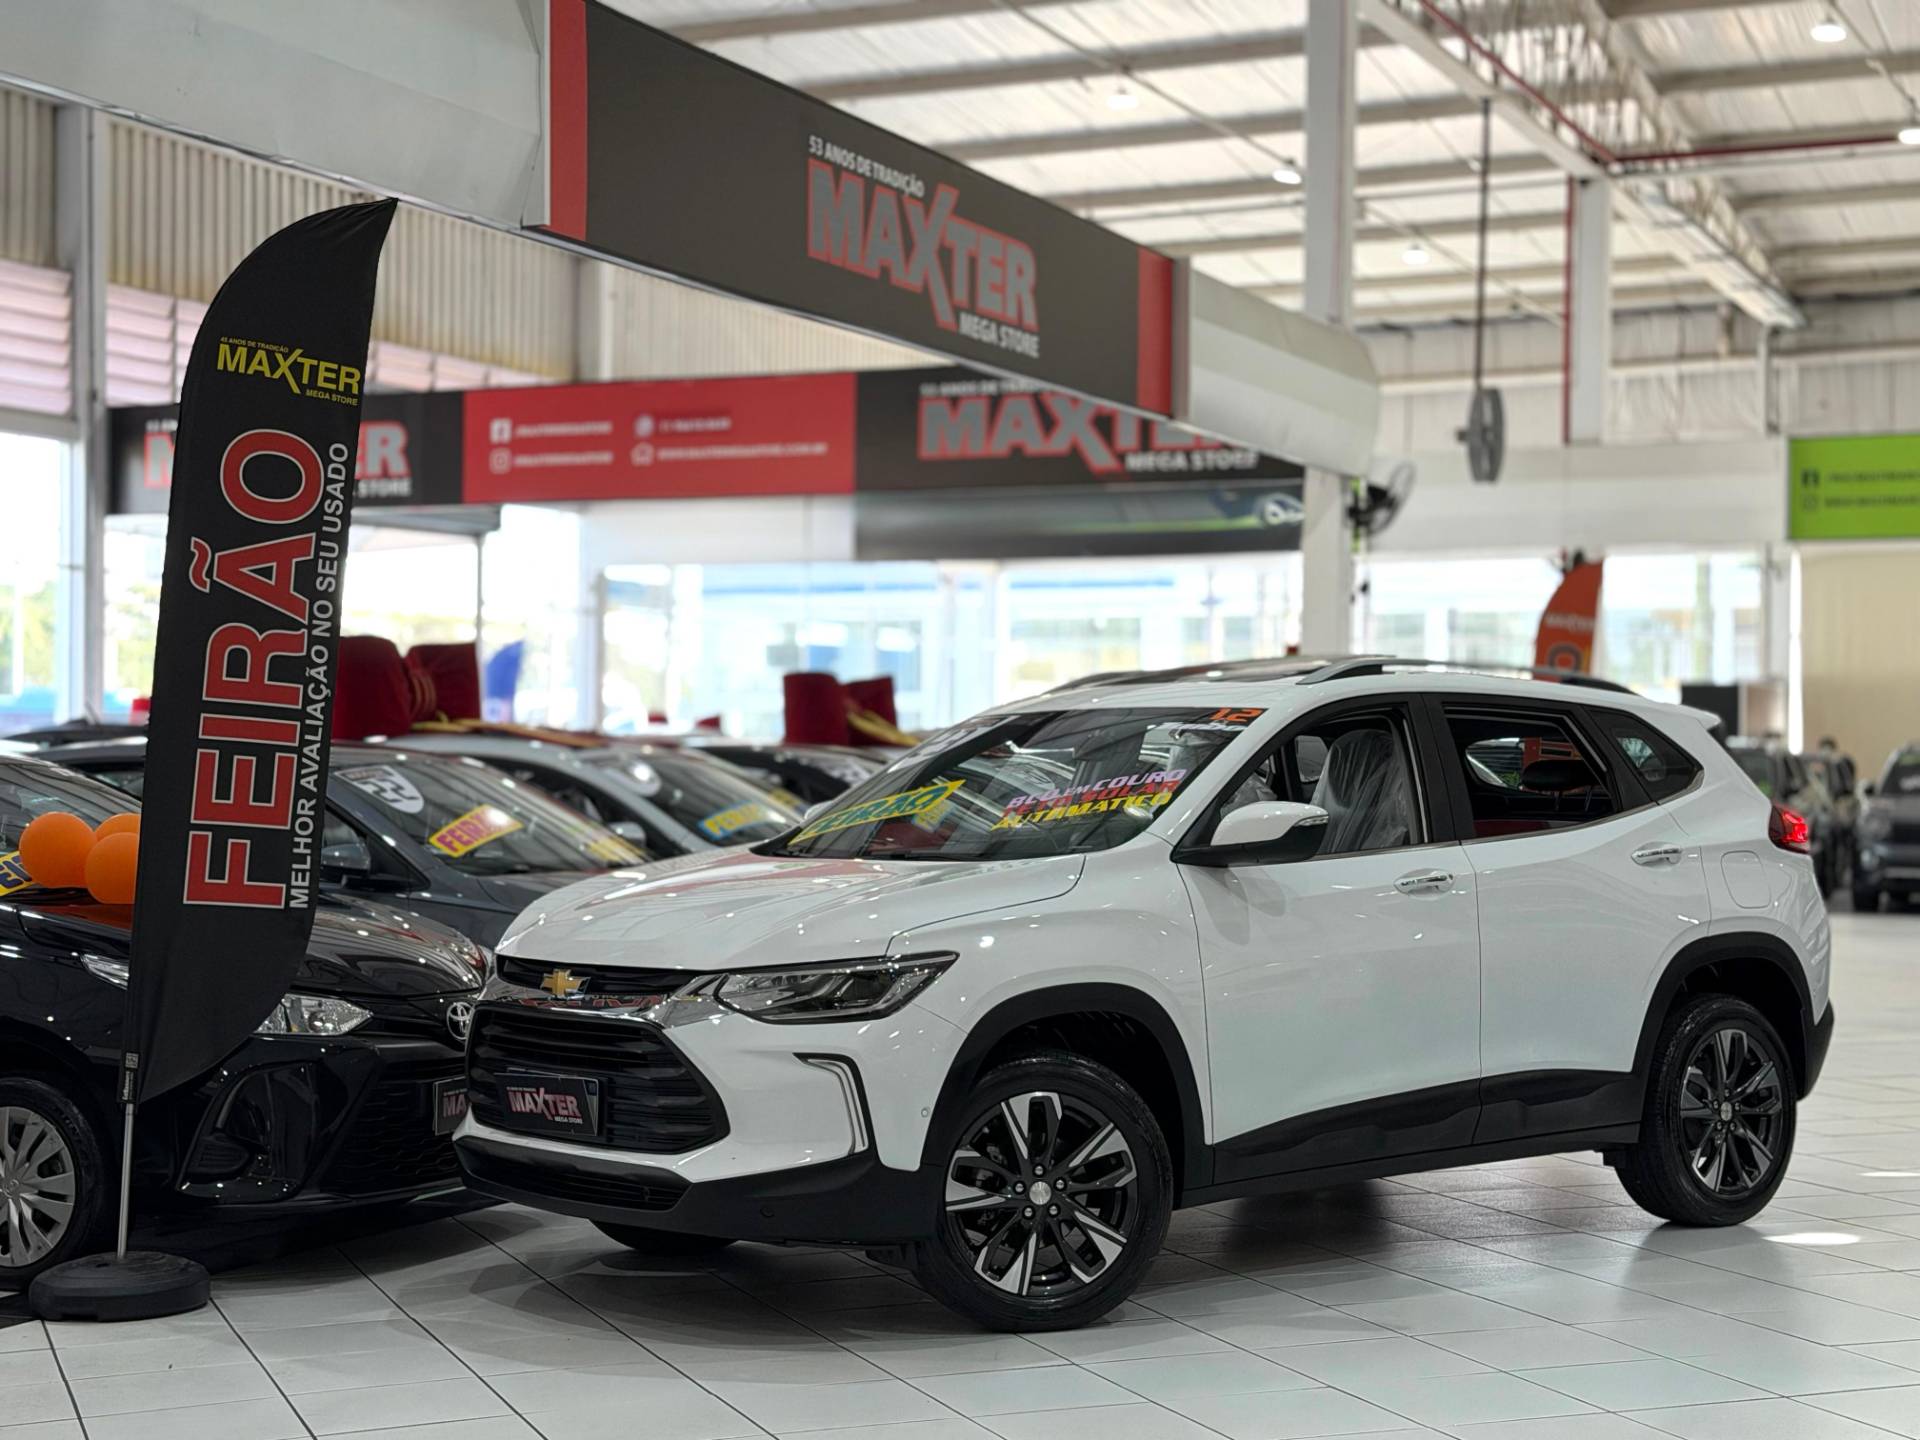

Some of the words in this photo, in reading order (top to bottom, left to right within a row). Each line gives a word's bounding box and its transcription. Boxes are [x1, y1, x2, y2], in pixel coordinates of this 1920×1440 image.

[808, 135, 823, 156] 53
[824, 142, 856, 170] ANOS
[856, 155, 872, 177] DE
[872, 161, 925, 199] TRADIÇÃO
[806, 156, 1041, 333] MAXTER
[247, 340, 257, 348] DE
[959, 311, 999, 347] MEGA
[999, 325, 1040, 359] STORE
[216, 343, 361, 395] MAXTER
[305, 388, 330, 400] MEGA
[331, 393, 358, 406] STORE
[1124, 450, 1190, 473] MEGA
[1191, 449, 1259, 470] STORE
[322, 442, 349, 534] USADO
[316, 540, 340, 593] SEU
[313, 599, 333, 637] NO
[183, 428, 324, 909] FEIRÃO
[300, 644, 331, 793] AVALIAÇÃO
[1081, 780, 1181, 801] SOLAR
[1094, 769, 1187, 791] COURO
[289, 798, 316, 909] MELHOR
[507, 1087, 582, 1121] MAXTER
